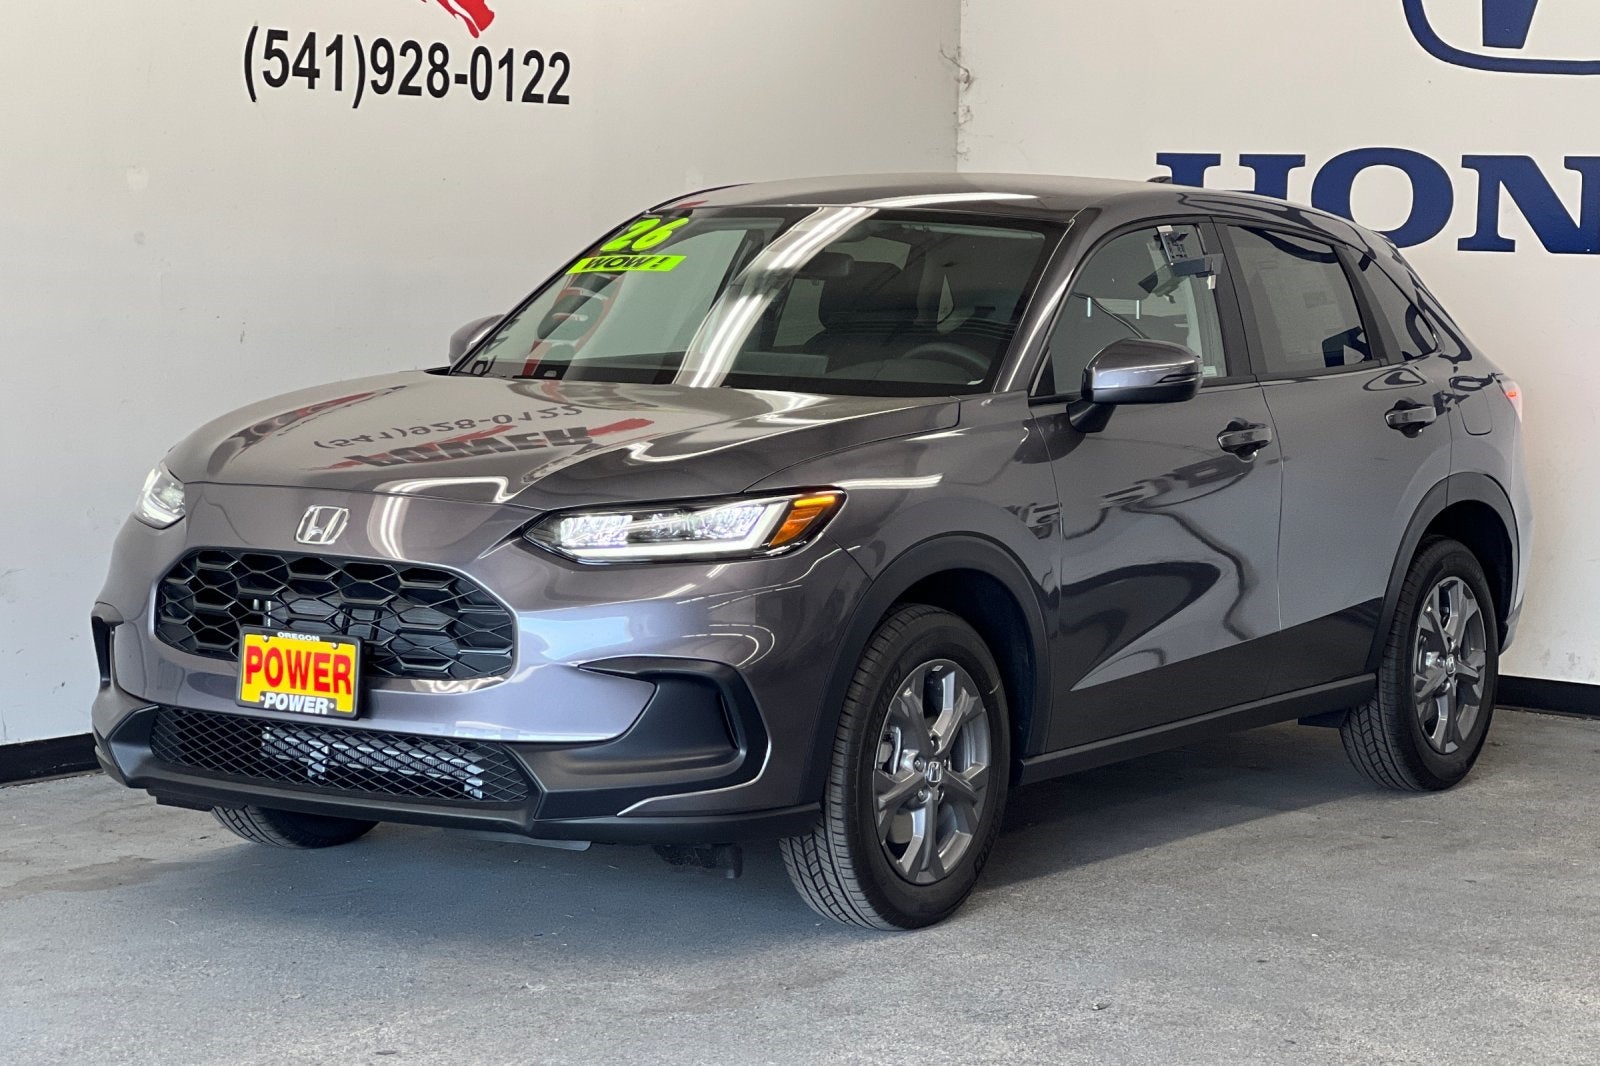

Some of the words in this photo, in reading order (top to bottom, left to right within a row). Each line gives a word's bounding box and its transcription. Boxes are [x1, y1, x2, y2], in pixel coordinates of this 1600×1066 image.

[244, 25, 571, 109] (541)928-0122
[600, 217, 690, 252] 26
[277, 631, 321, 642] OREGON
[245, 645, 353, 696] POWER
[263, 692, 329, 715] POWER
